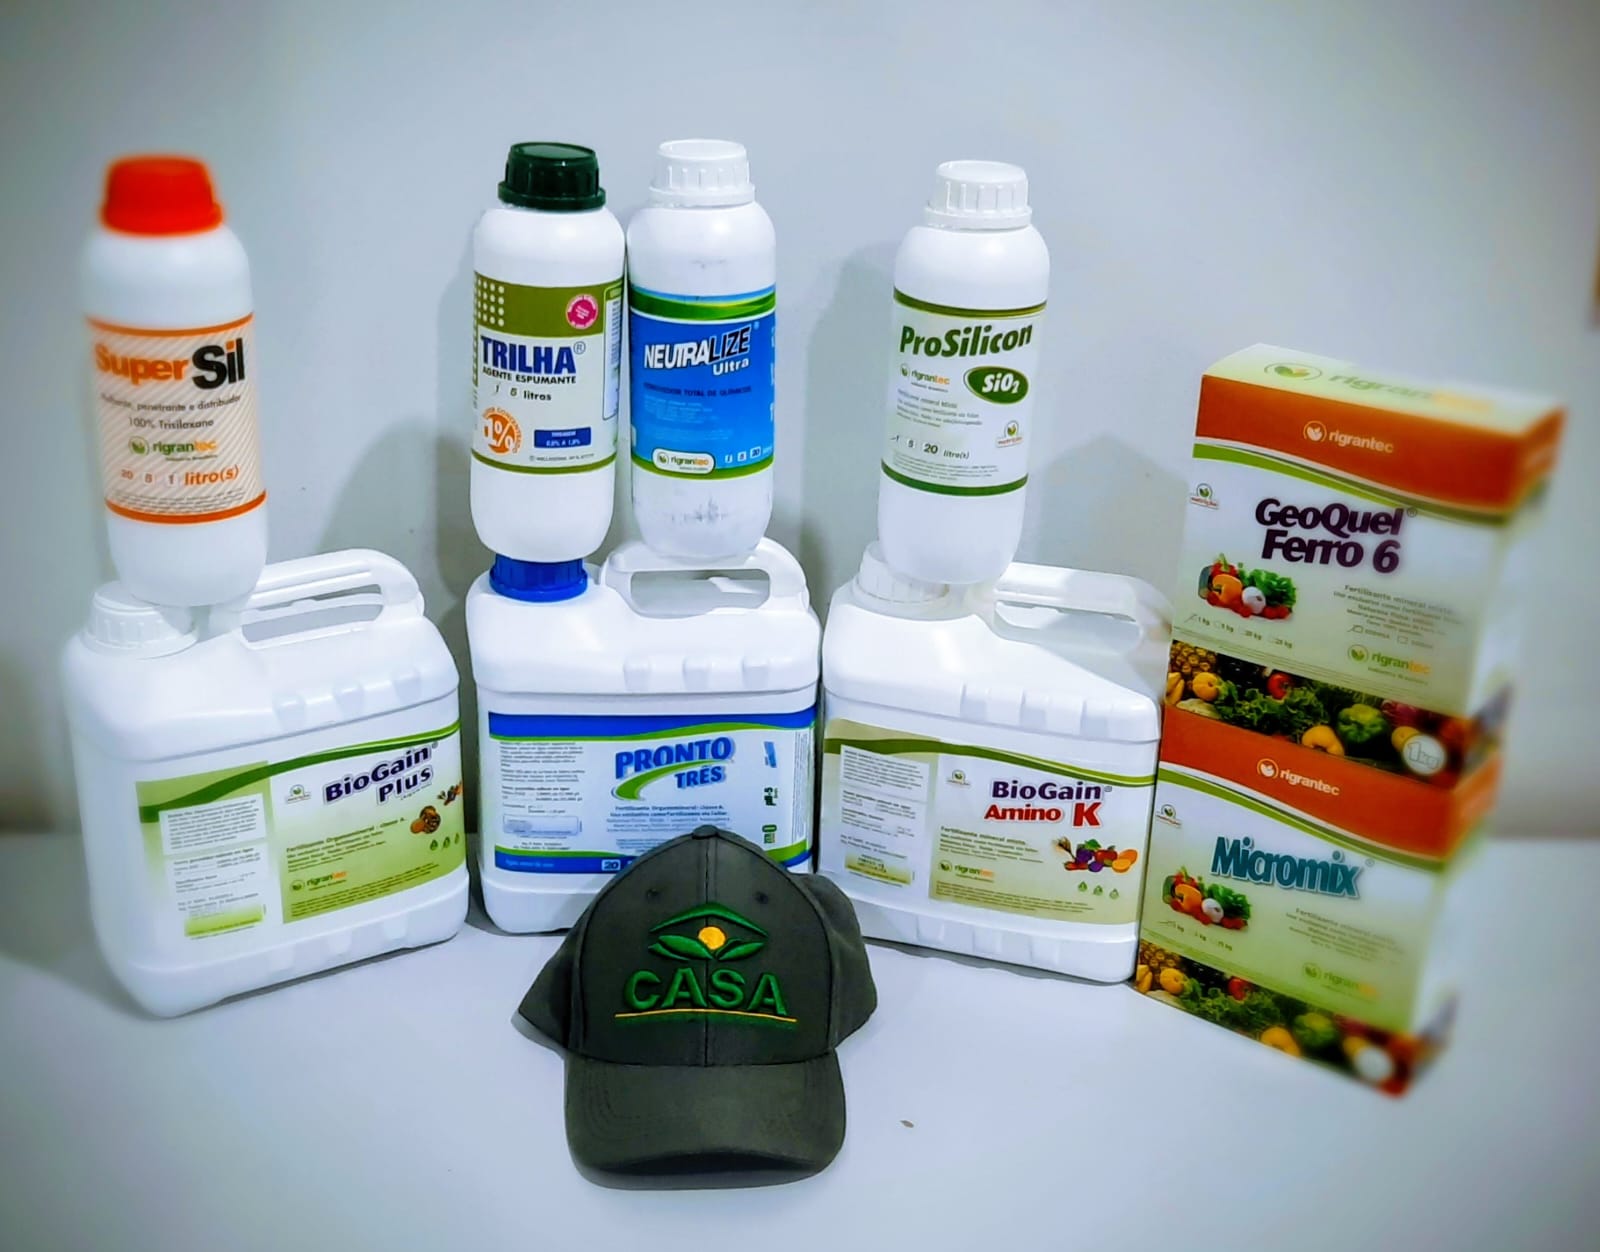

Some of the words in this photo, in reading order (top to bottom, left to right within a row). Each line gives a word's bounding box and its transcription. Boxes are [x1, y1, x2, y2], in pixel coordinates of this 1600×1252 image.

[643, 326, 752, 369] NEUTRALIZE
[899, 324, 1033, 358] ProSilicon
[480, 335, 577, 375] TRILHA
[713, 357, 749, 376] Ultra
[482, 366, 512, 381] AGENTE
[515, 374, 577, 384] ESPUMANTE
[911, 370, 950, 385] rigrantec
[523, 390, 552, 401] litros
[152, 439, 217, 456] rigrantec
[923, 444, 938, 454] 20
[1328, 430, 1394, 454] rigrantec
[670, 456, 710, 467] rigrantec
[184, 464, 240, 486] litro(s)
[1255, 498, 1404, 538] GeoQuel
[1261, 529, 1364, 568] Ferro
[1372, 540, 1401, 574] 6
[615, 737, 733, 779] PRONTO
[325, 747, 430, 803] BioGain
[379, 768, 431, 803] Plus
[675, 765, 723, 789] TRÊS
[1280, 768, 1340, 795] rigrantec
[992, 780, 1101, 800] BioGain
[984, 804, 1062, 821] Amino
[1073, 802, 1101, 826] K
[604, 861, 619, 869] 20
[1211, 836, 1360, 898] Micromix
[623, 967, 788, 1016] CASA
